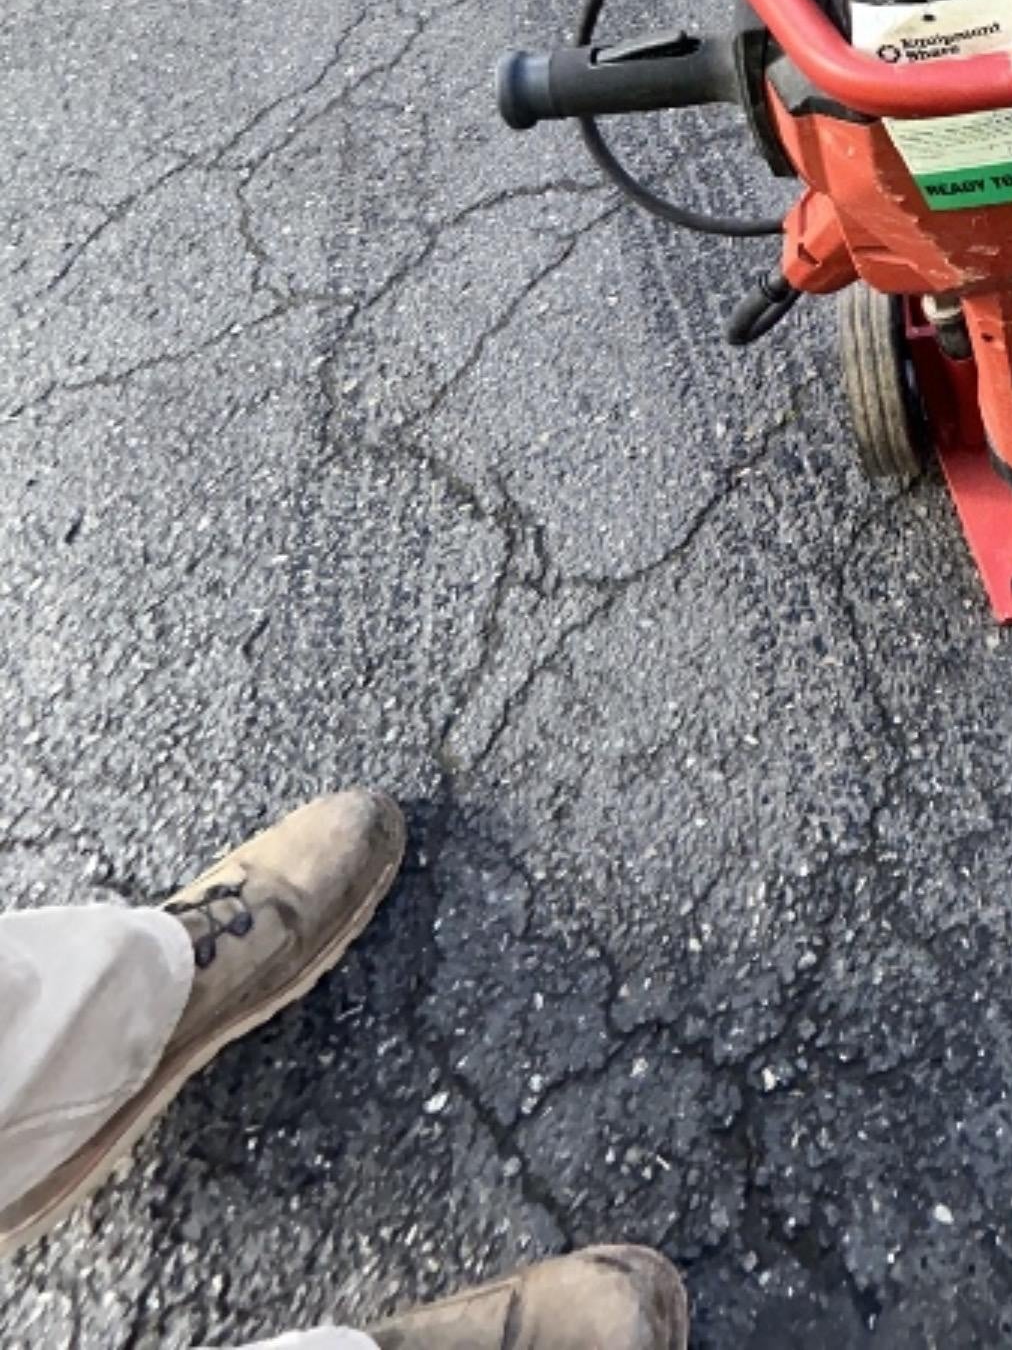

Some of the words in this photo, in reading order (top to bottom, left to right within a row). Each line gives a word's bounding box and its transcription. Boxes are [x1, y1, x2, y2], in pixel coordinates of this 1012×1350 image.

[901, 22, 1001, 49] Equipment
[905, 45, 961, 62] Share
[927, 177, 985, 197] READY
